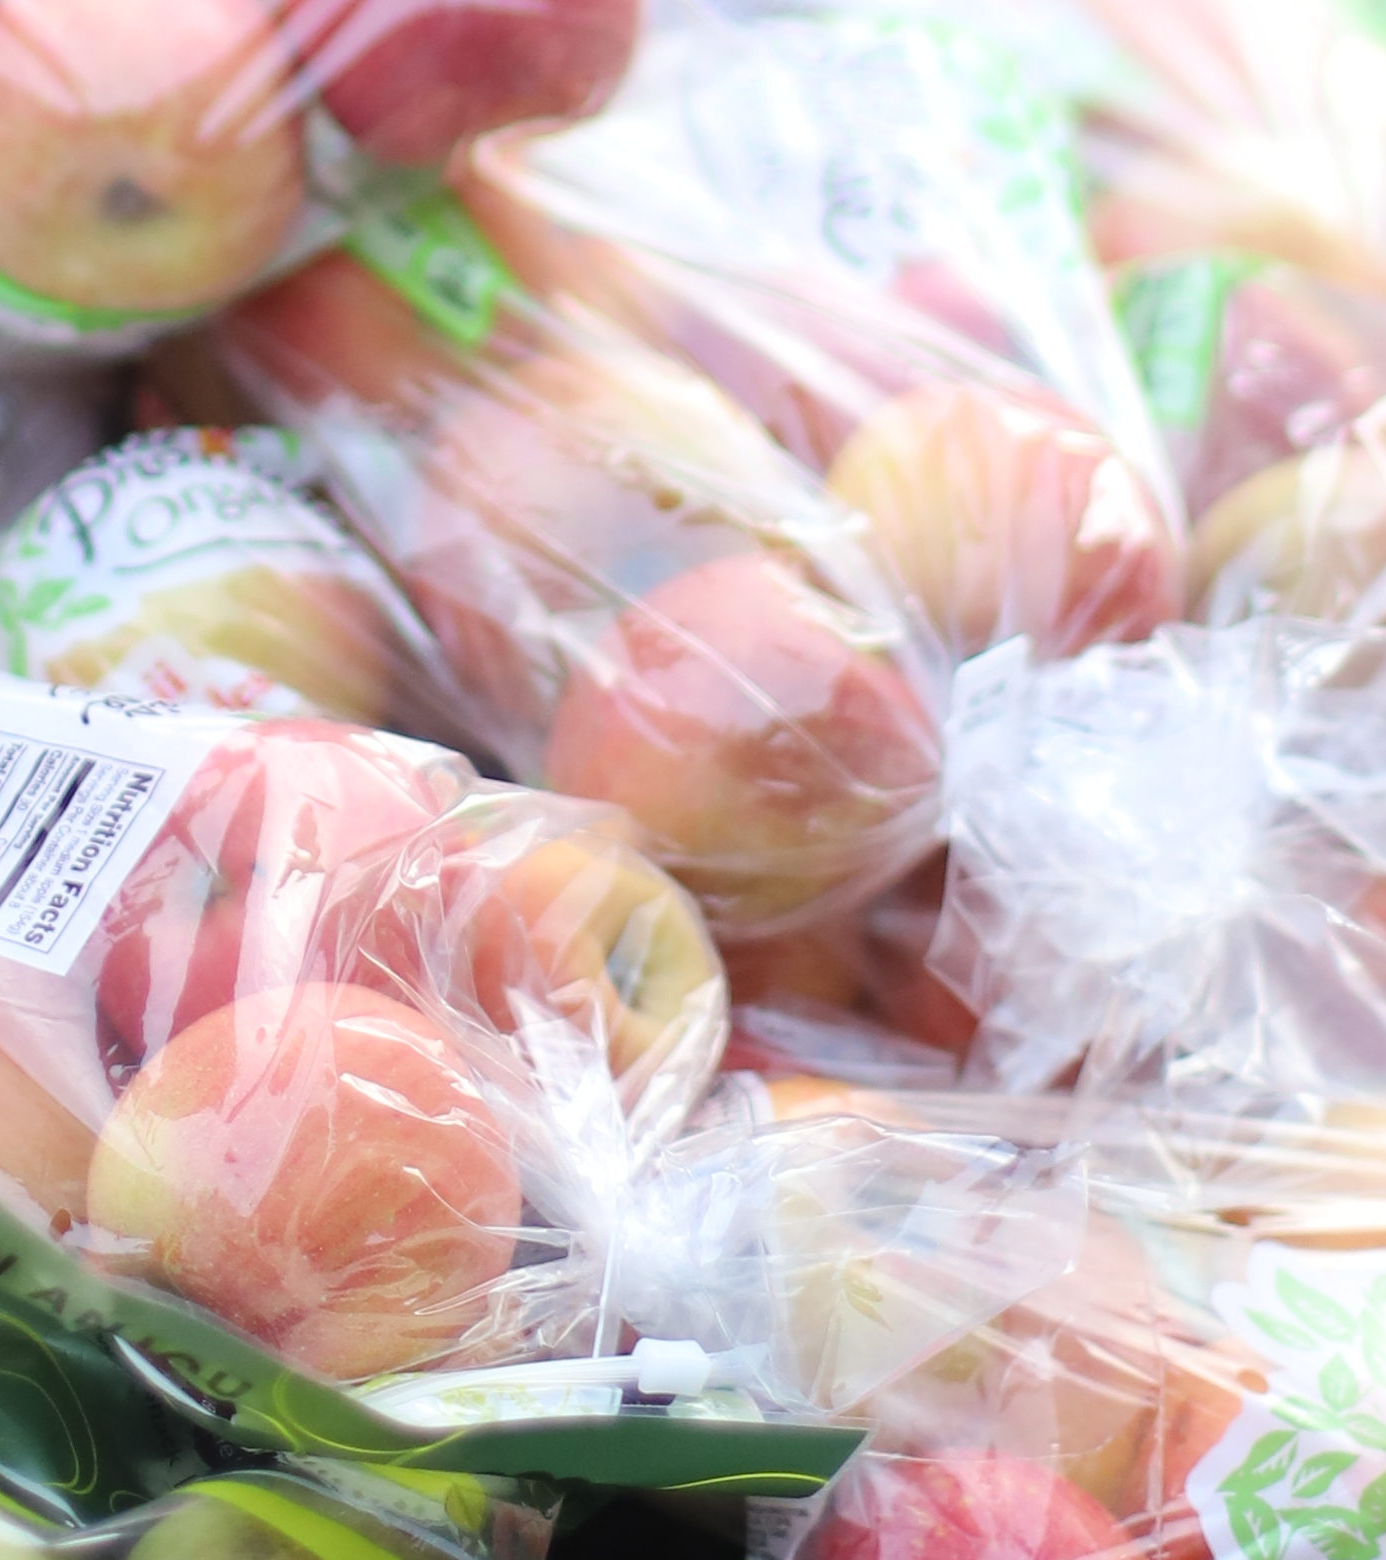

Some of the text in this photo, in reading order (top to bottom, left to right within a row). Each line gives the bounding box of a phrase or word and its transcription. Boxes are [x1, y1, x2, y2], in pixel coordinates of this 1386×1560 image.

[25, 749, 62, 797] Calories
[51, 755, 80, 793] Amount
[94, 768, 128, 804] Serving
[12, 812, 44, 850] Serving
[64, 805, 84, 824] Per
[69, 770, 153, 875] Nutrition
[33, 822, 71, 872] Container
[50, 835, 80, 876] medium
[14, 871, 38, 900] about
[23, 880, 83, 947] Facts
